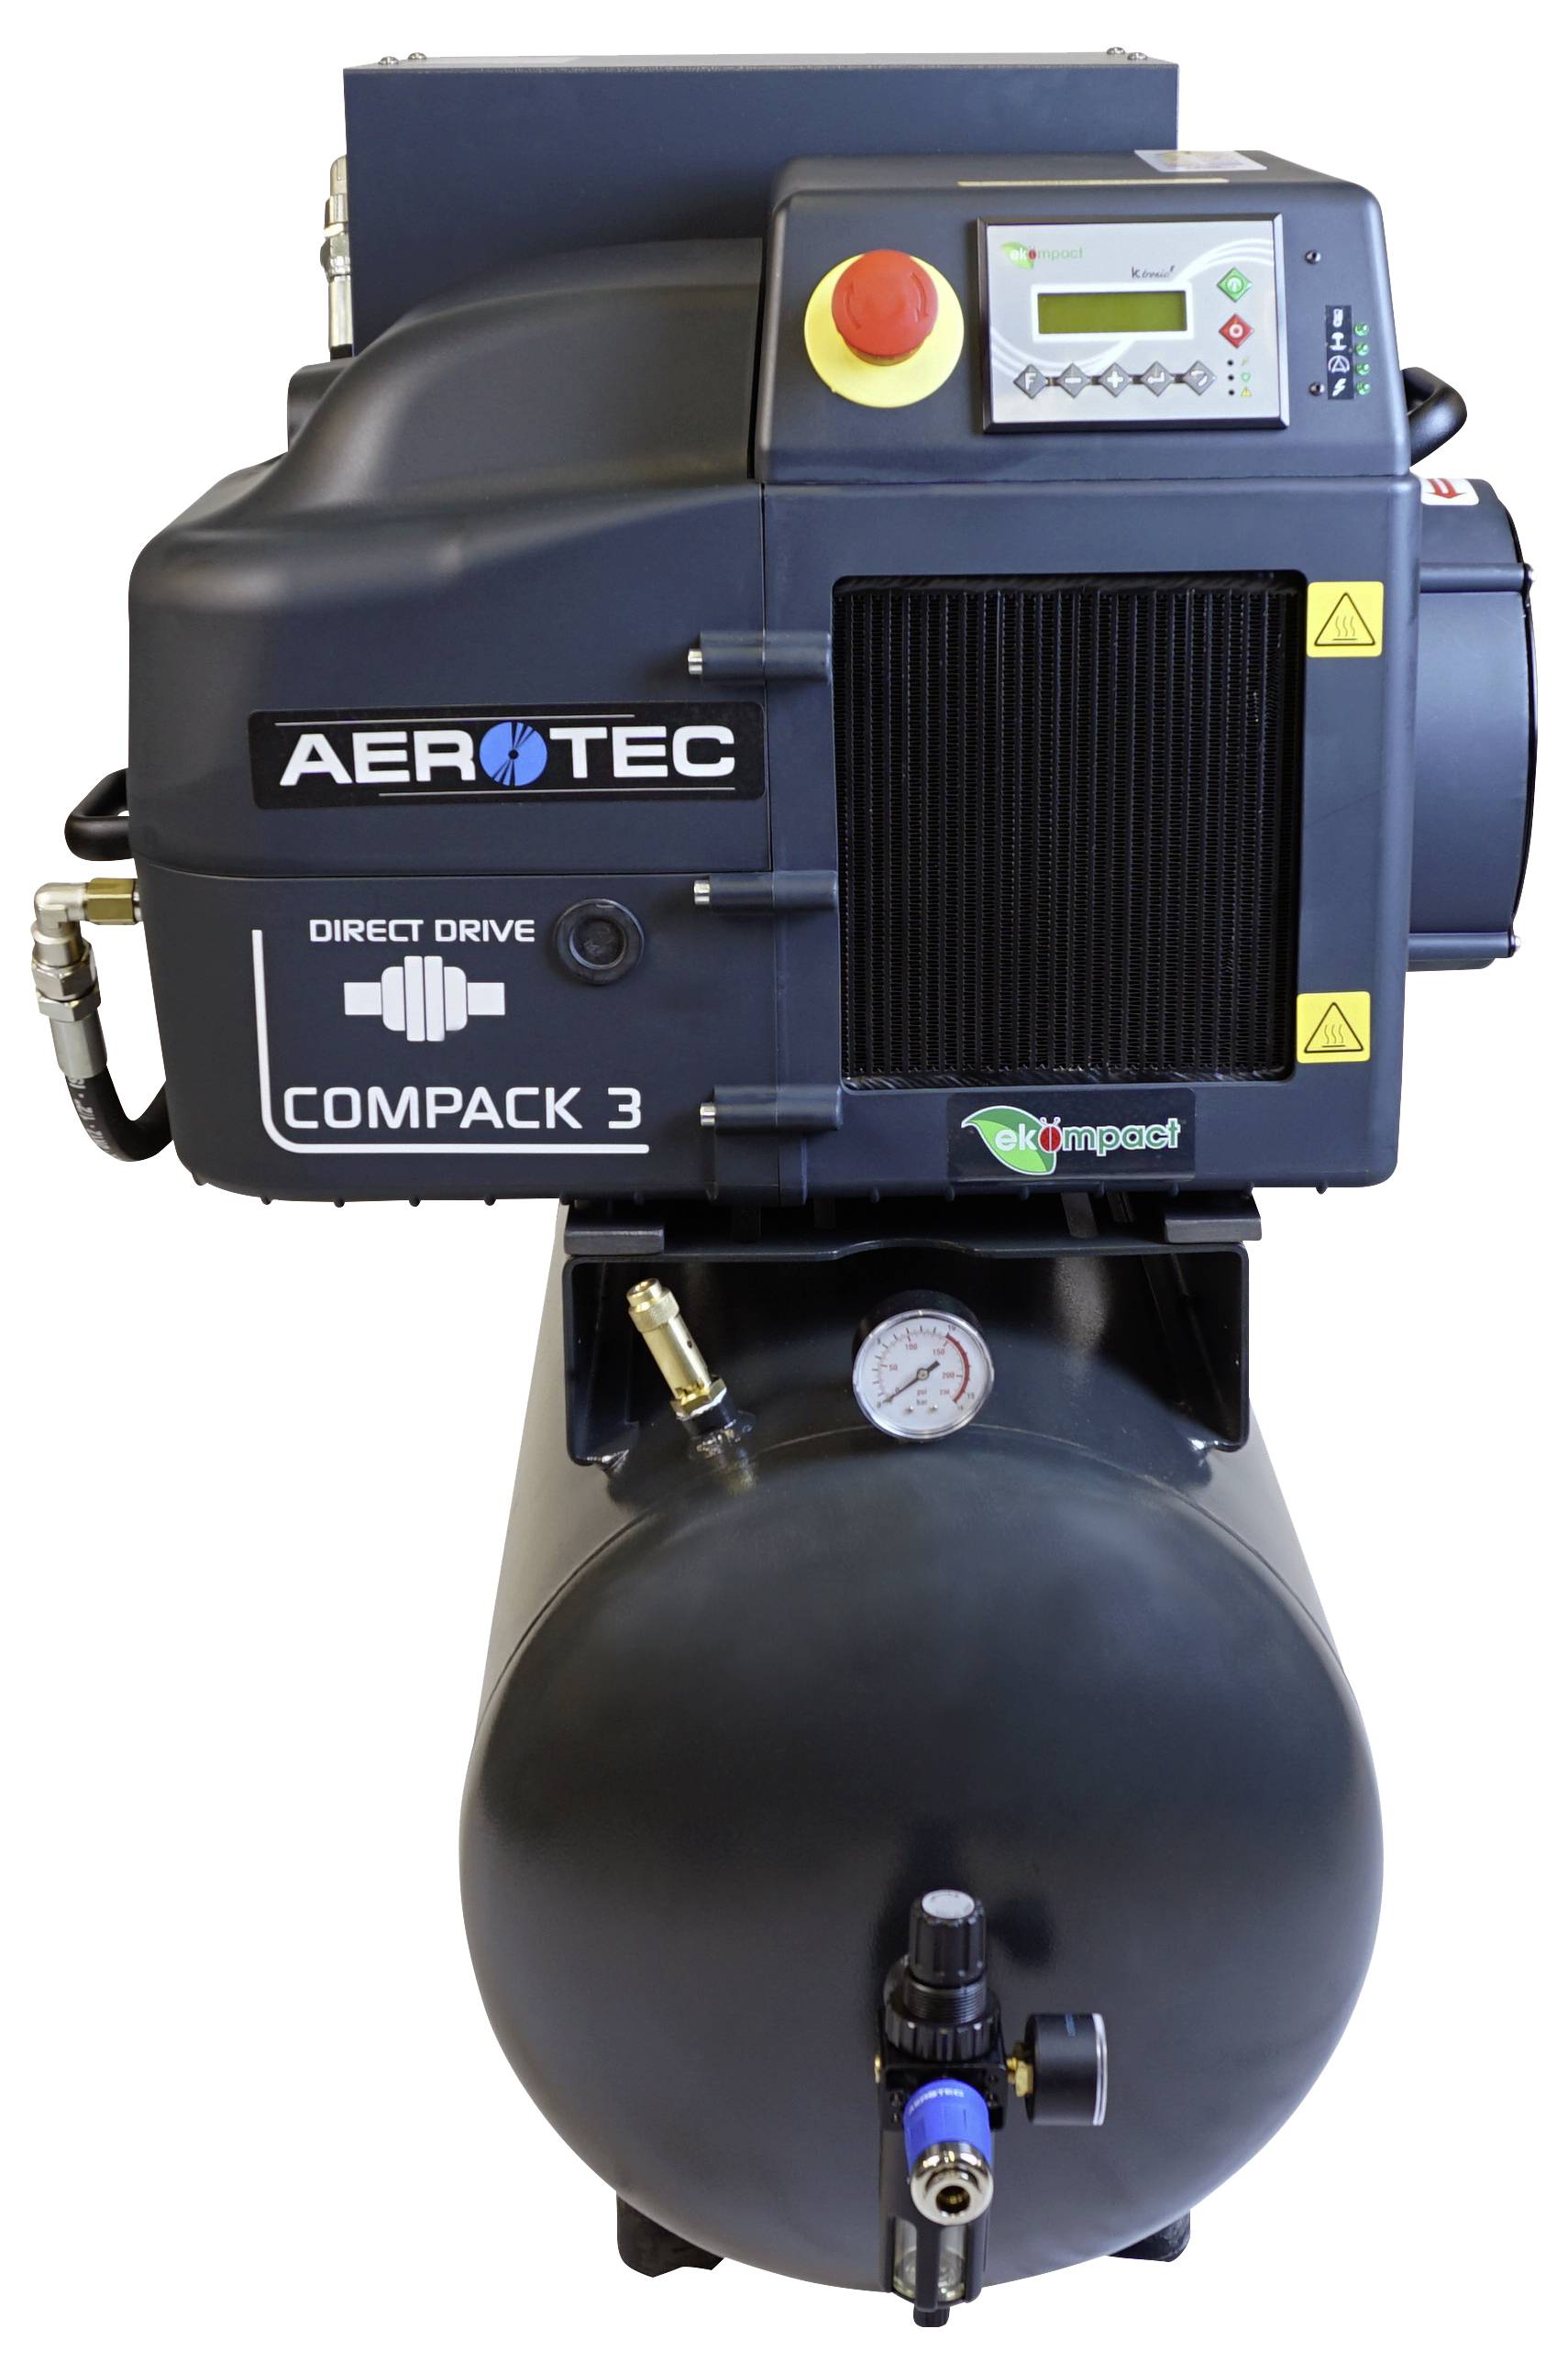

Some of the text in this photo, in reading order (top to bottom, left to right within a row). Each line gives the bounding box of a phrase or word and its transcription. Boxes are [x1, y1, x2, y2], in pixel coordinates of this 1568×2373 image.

[1024, 373, 1036, 391] F
[279, 722, 735, 787] AEROTEC
[308, 918, 536, 944] DIRECT DRIVE
[283, 1085, 643, 1131] COMPACK 3
[933, 1348, 945, 1356] 150
[889, 1363, 899, 1372] 50
[943, 1372, 955, 1380] 200
